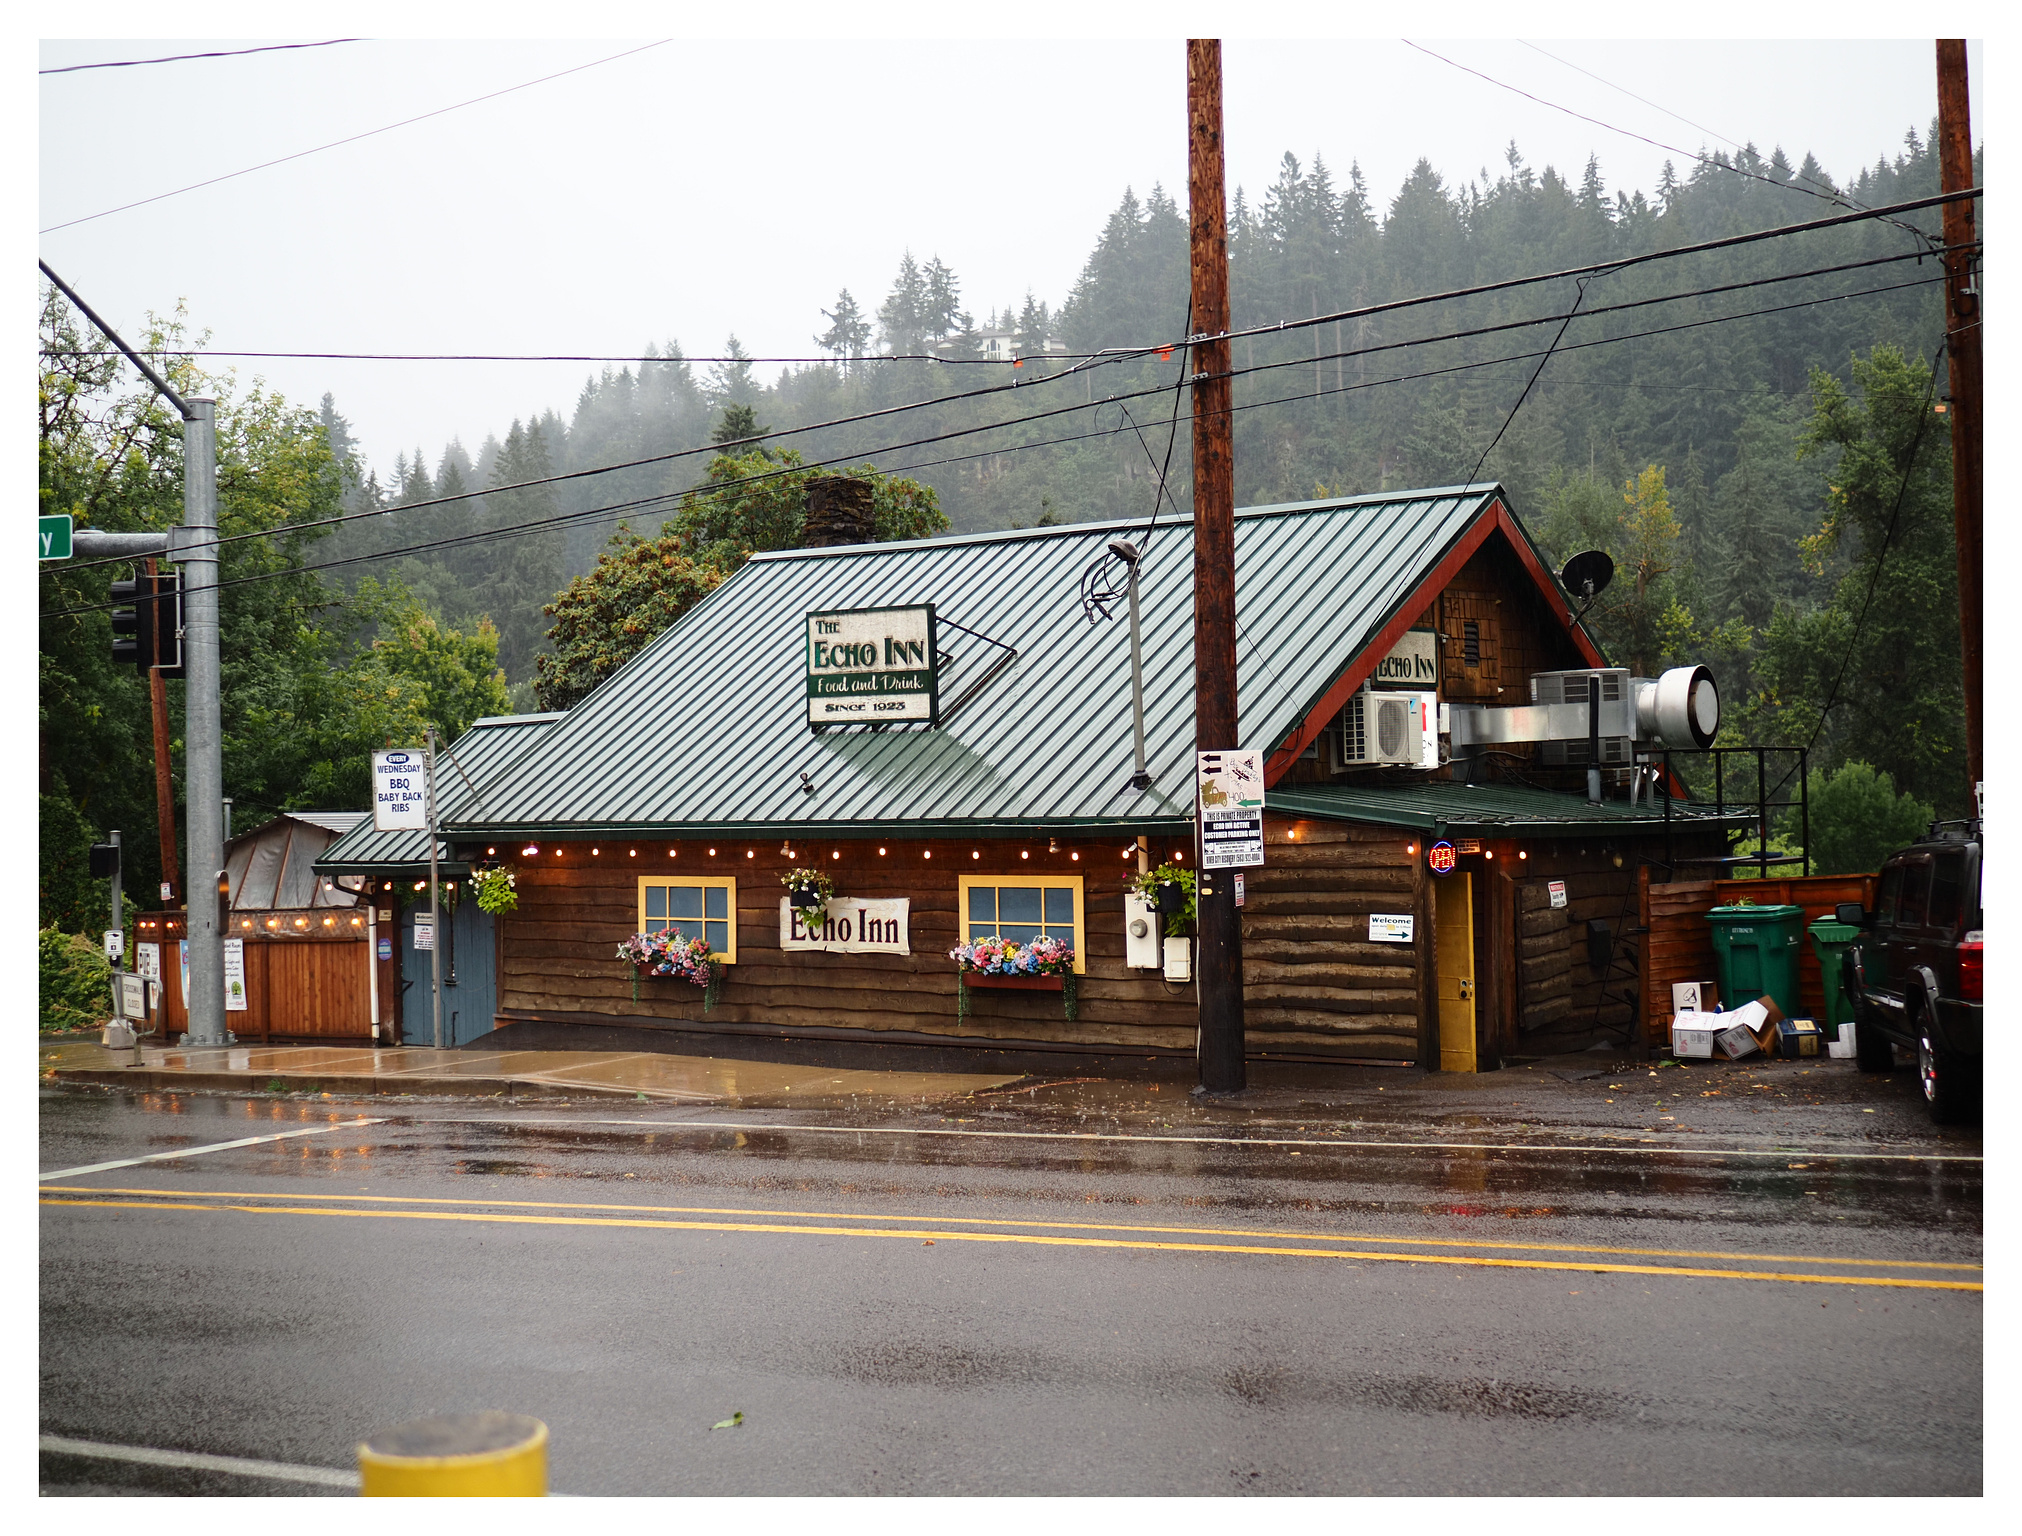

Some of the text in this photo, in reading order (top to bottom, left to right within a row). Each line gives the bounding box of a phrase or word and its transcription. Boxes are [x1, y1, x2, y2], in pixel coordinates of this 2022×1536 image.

[815, 620, 840, 634] THE
[814, 636, 924, 668] ECHO INN
[1378, 653, 1435, 679] ECHO INN
[817, 674, 924, 693] Food and Drink
[824, 703, 866, 713] SINCE
[388, 755, 407, 763] EVERY
[377, 764, 421, 774] WEDNESDAY
[389, 778, 410, 790] BBQ
[378, 791, 423, 802] BABY BACK
[391, 803, 410, 813] RIBS
[1206, 812, 1216, 820] THIS
[1220, 811, 1236, 820] PRIVATE
[1236, 810, 1257, 819] PROPERTY
[1204, 829, 1260, 840] CUSTOMER PARKING ONLY
[1429, 847, 1456, 868] OPEN
[790, 908, 899, 943] Echo Inn
